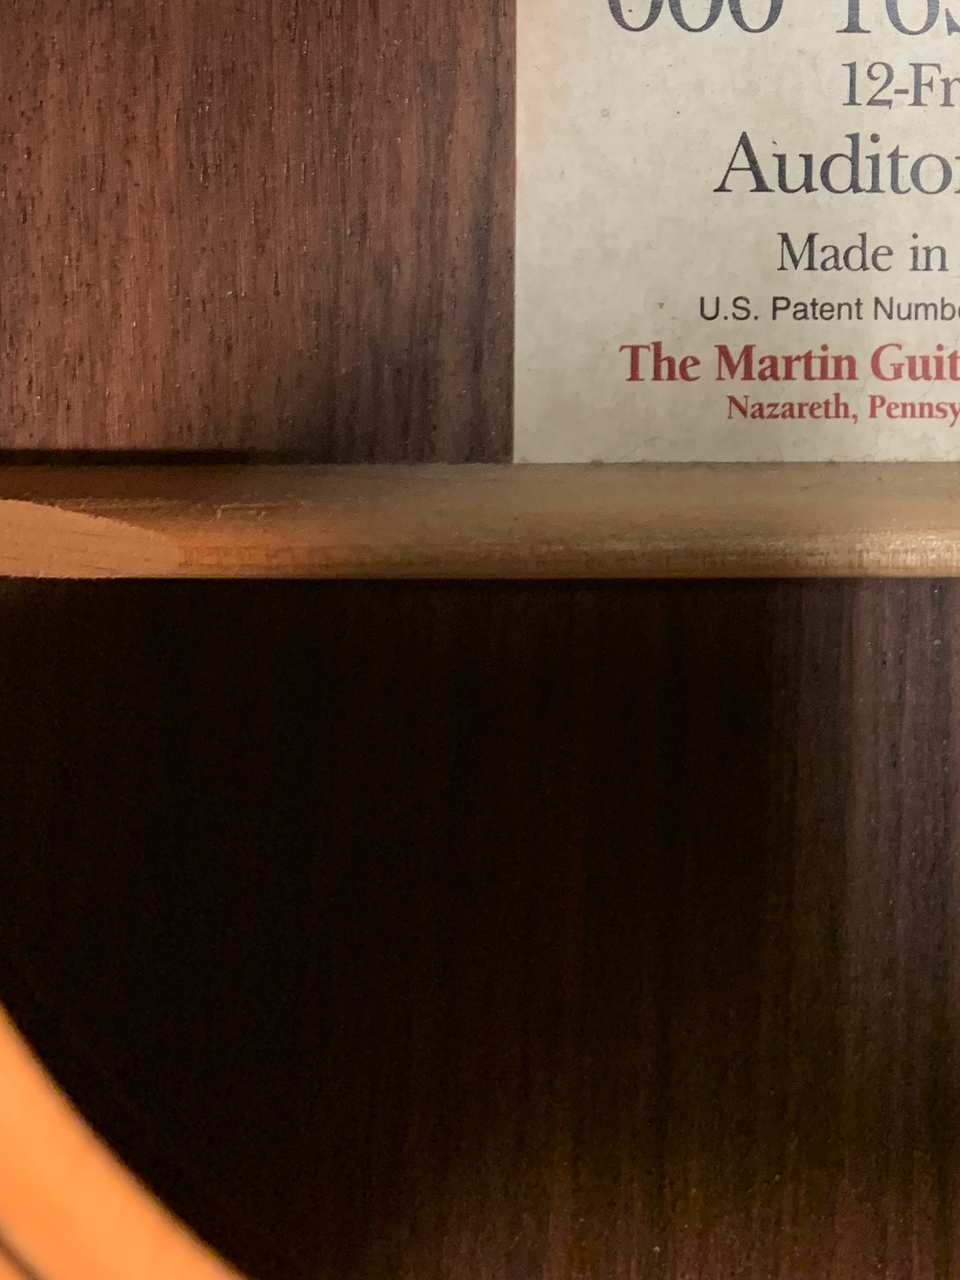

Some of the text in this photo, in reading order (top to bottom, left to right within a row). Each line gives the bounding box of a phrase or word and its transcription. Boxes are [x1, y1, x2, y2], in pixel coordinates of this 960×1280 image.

[777, 232, 893, 273] Made
[909, 233, 950, 272] in
[700, 296, 759, 322] U.S.
[772, 296, 864, 322] Patent
[619, 341, 701, 383] The
[714, 344, 860, 382] Martin
[727, 394, 858, 424] Nazareth,
